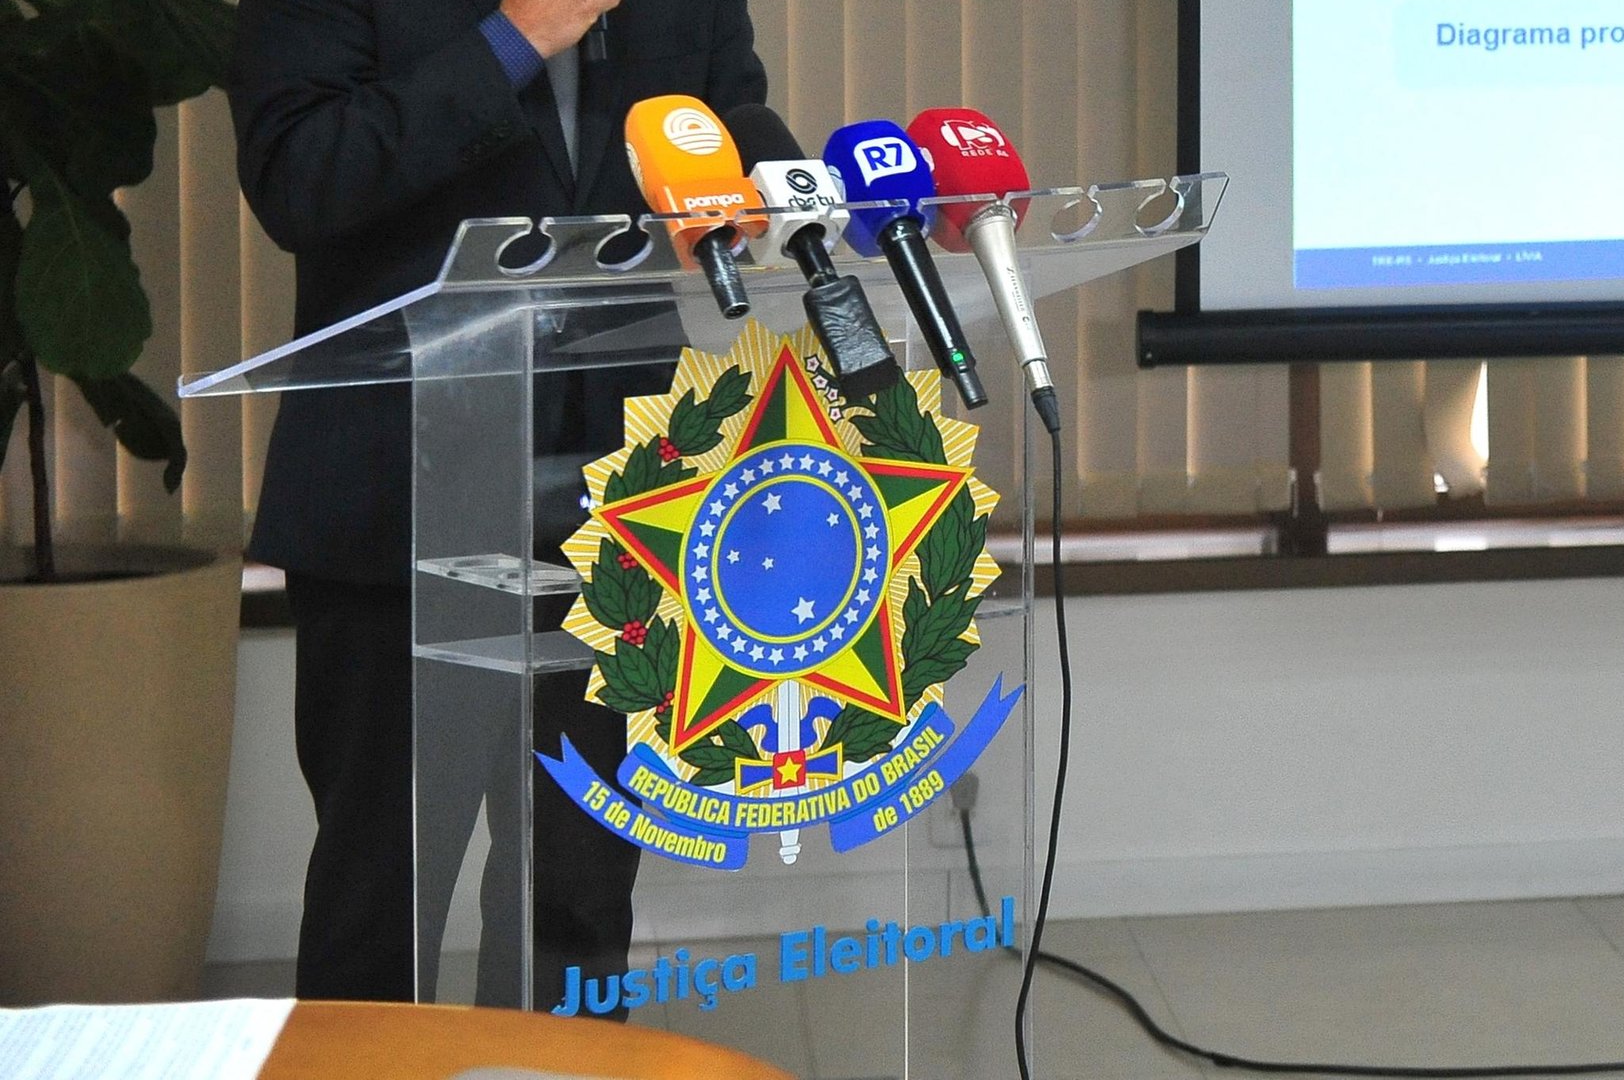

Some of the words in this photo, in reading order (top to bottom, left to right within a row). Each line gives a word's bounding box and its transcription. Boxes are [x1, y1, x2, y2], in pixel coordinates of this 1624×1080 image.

[1436, 21, 1571, 51] Diagrama
[862, 142, 905, 171] R7
[684, 193, 745, 210] pampa
[628, 765, 730, 826] REPÚBLICA
[735, 792, 850, 827] FEDERATIVA
[852, 777, 879, 802] DO
[882, 726, 945, 783] BRASIL
[873, 808, 898, 833] de
[900, 772, 945, 818] 1889
[583, 781, 604, 811] 15
[604, 797, 630, 828] de
[629, 814, 726, 863] Novembro
[552, 948, 757, 1017] Justiça
[780, 896, 1015, 983] Eleitoral
